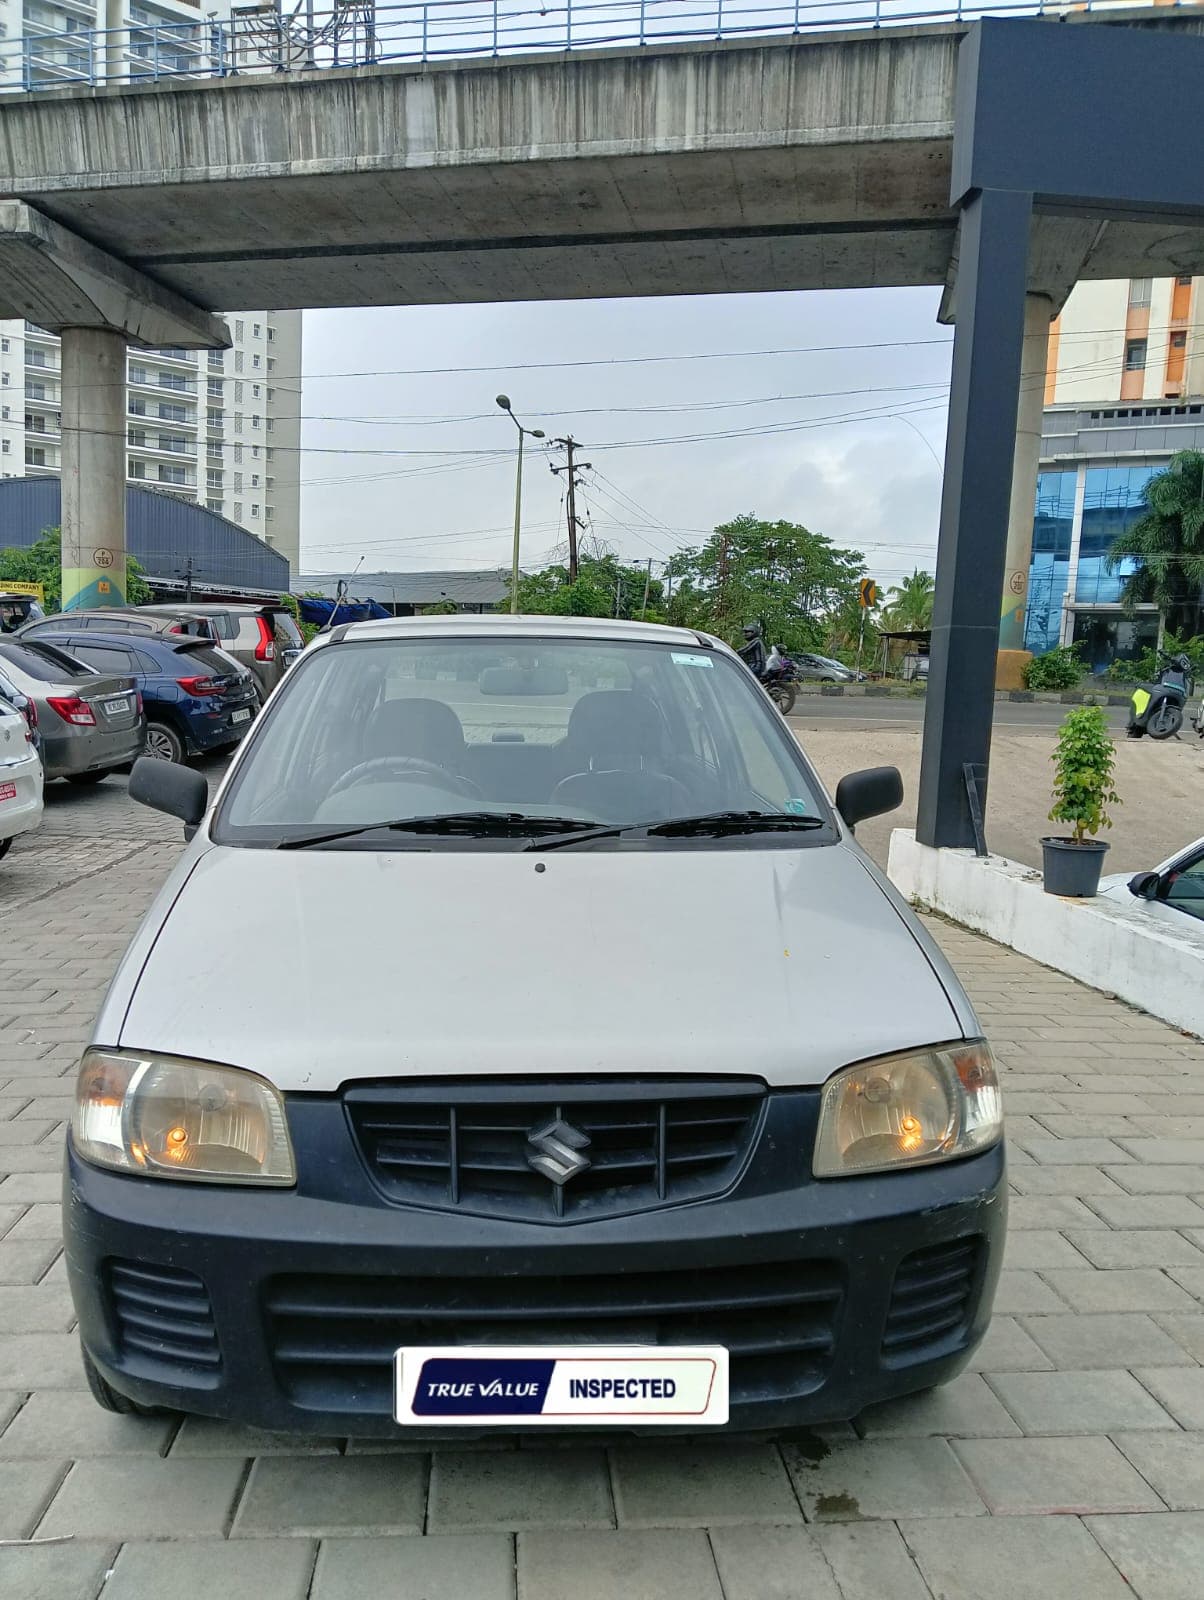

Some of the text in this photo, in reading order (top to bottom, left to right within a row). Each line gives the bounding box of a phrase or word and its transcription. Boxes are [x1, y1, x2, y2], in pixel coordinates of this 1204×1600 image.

[427, 1378, 539, 1398] TRUE VALUE
[569, 1378, 677, 1399] INSPECTED
